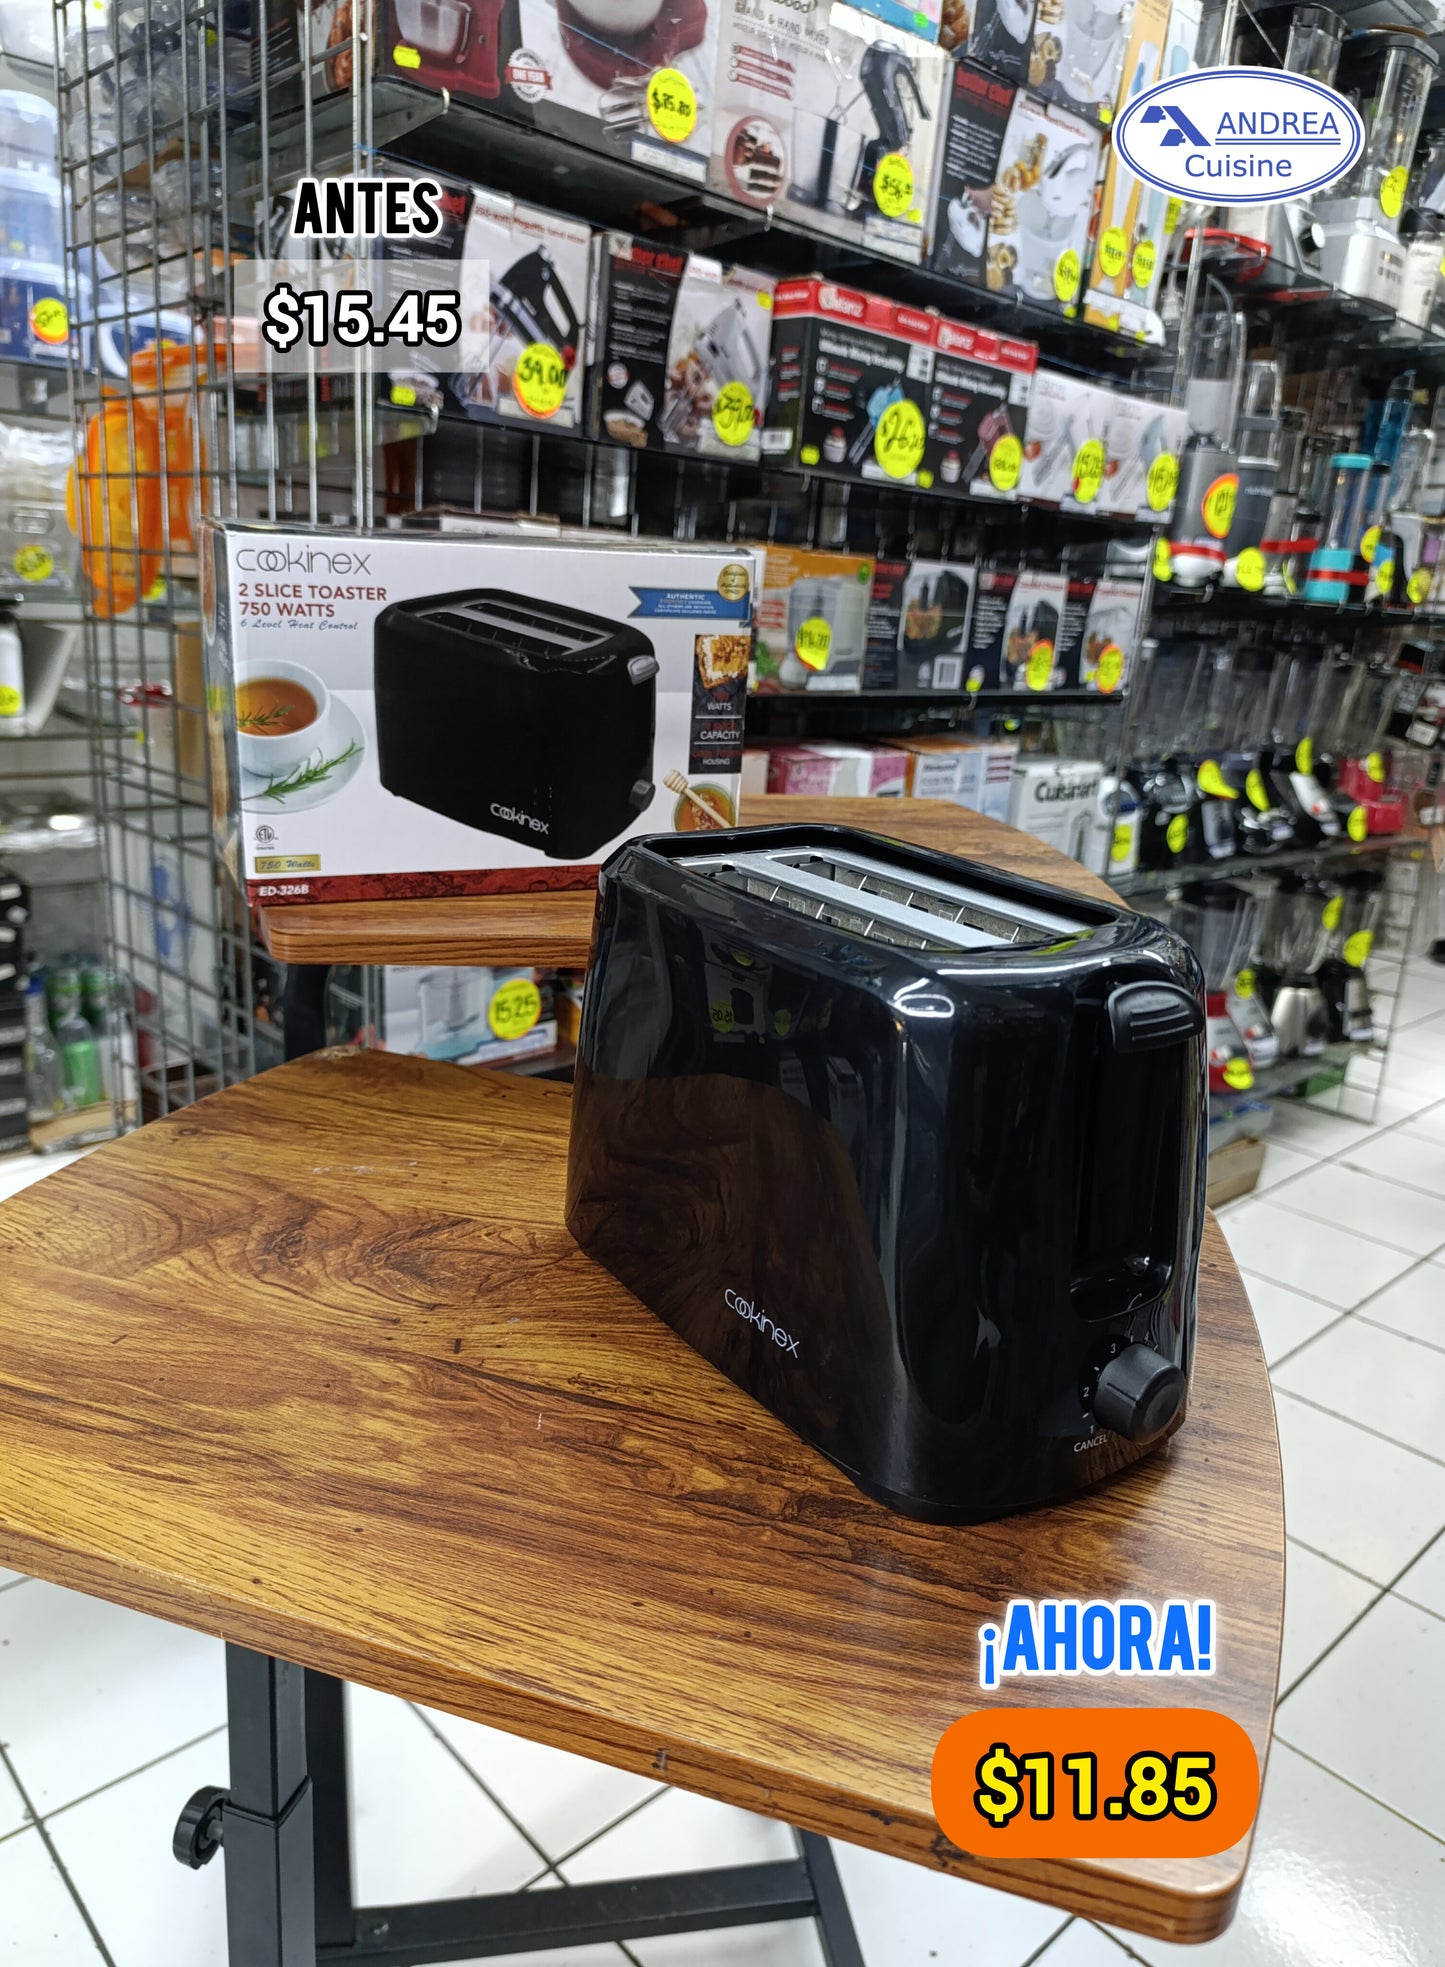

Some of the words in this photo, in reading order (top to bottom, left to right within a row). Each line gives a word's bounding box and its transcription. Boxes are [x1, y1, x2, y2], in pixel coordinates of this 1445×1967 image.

[236, 543, 371, 576] cookinex
[239, 583, 249, 597] 2
[255, 583, 303, 598] SLICE
[308, 585, 387, 601] TOASTER
[239, 602, 271, 616] 750
[276, 603, 335, 618] WATTS
[240, 619, 247, 628] 6
[252, 619, 282, 629] Level
[288, 619, 315, 629] Heat
[319, 620, 359, 631] Control
[707, 702, 732, 711] WATTS
[700, 731, 740, 740] CAPACITY
[490, 803, 549, 835] cookinex
[259, 884, 309, 896] ED-326B
[725, 1289, 800, 1359] cookinex
[1110, 1343, 1116, 1354] 3
[1083, 1387, 1089, 1397] 2
[1089, 1425, 1094, 1434] 1
[1073, 1434, 1108, 1452] CANCEL
